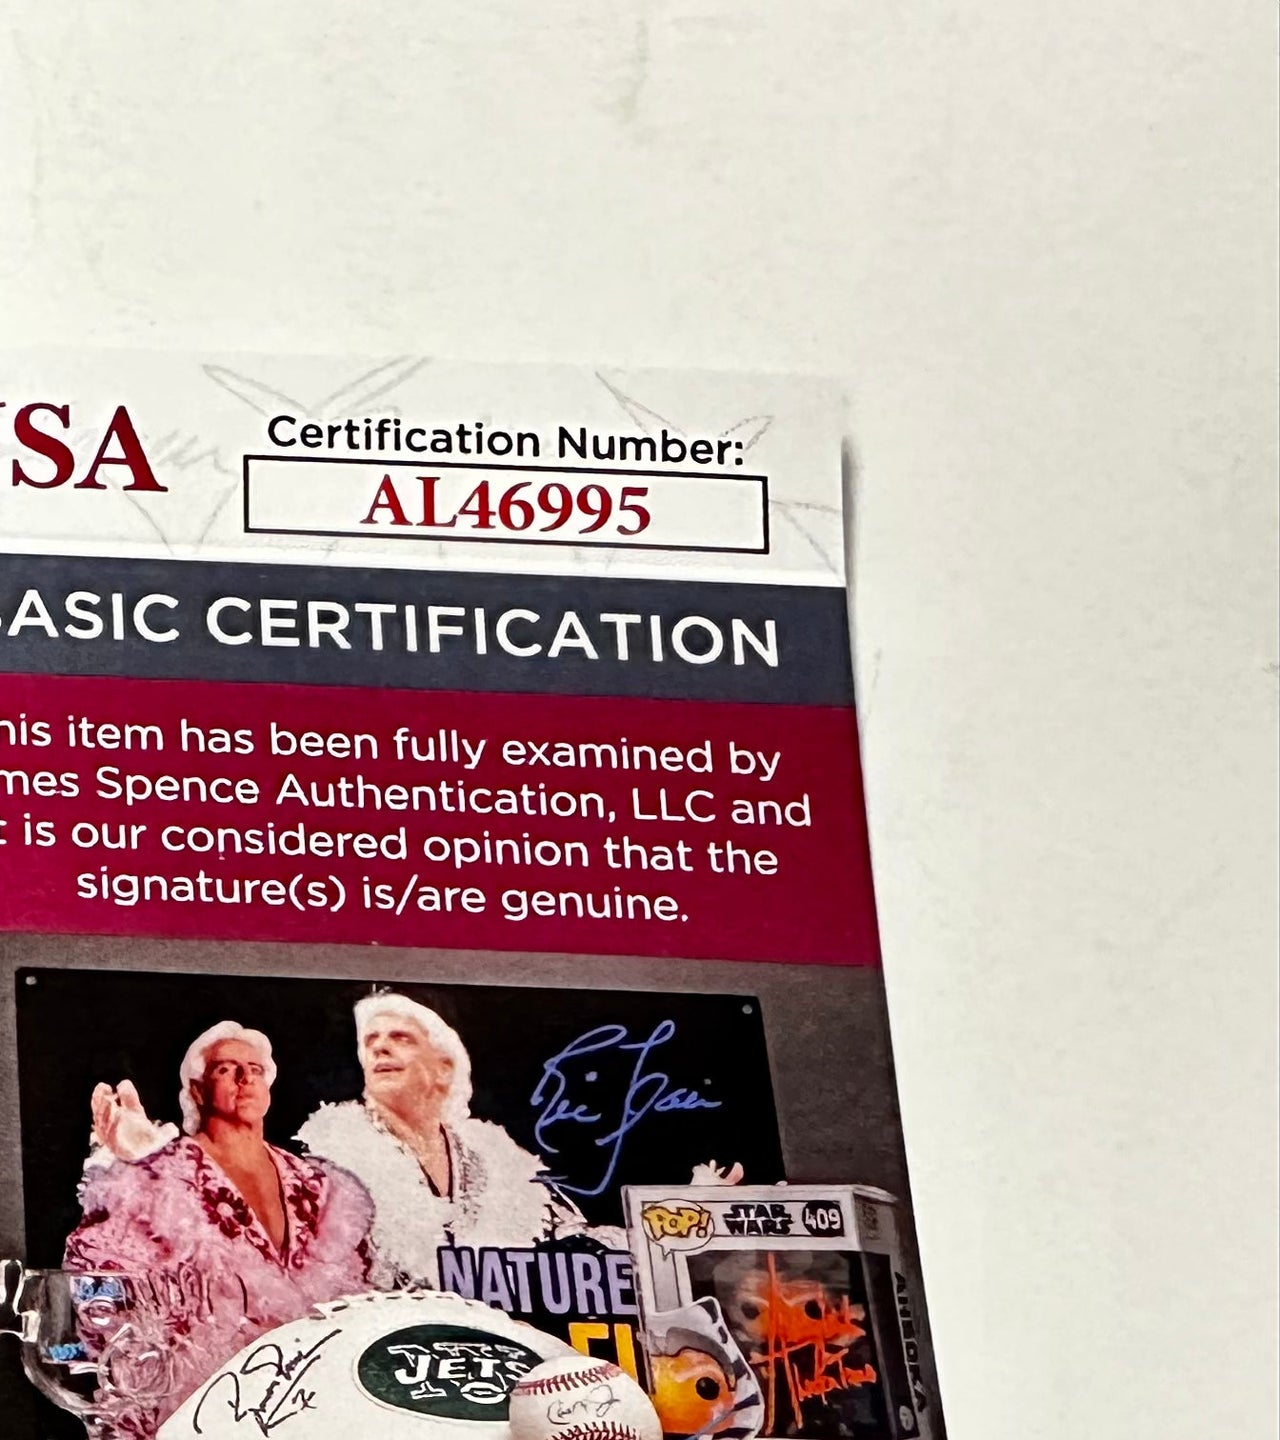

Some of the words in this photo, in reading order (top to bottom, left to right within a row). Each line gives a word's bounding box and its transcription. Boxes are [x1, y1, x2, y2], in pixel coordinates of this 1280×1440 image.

[267, 415, 541, 458] Certification
[557, 427, 745, 467] Number:
[360, 474, 653, 537] AL46995
[205, 598, 781, 668] CERTIFICATION
[67, 714, 164, 751] item
[180, 718, 255, 755] has
[270, 722, 378, 760] been
[393, 727, 487, 770] fully
[502, 737, 714, 775] examined
[729, 741, 782, 783] by
[96, 766, 260, 807] Spence
[275, 773, 616, 823] Authentication,
[632, 787, 716, 824] LLC
[731, 793, 813, 828] and
[23, 813, 56, 848] is
[71, 822, 147, 851] our
[161, 820, 409, 861] considered
[423, 830, 589, 869] opinion
[603, 836, 694, 873] that
[707, 840, 778, 876] the
[77, 865, 347, 913] signature(s)
[363, 874, 486, 916] is/are
[501, 889, 690, 926] genuine.
[640, 1205, 710, 1241] POP!
[723, 1204, 792, 1220] STAR
[724, 1218, 794, 1235] WARS
[804, 1207, 841, 1231] 409
[439, 1250, 639, 1315] NATURE
